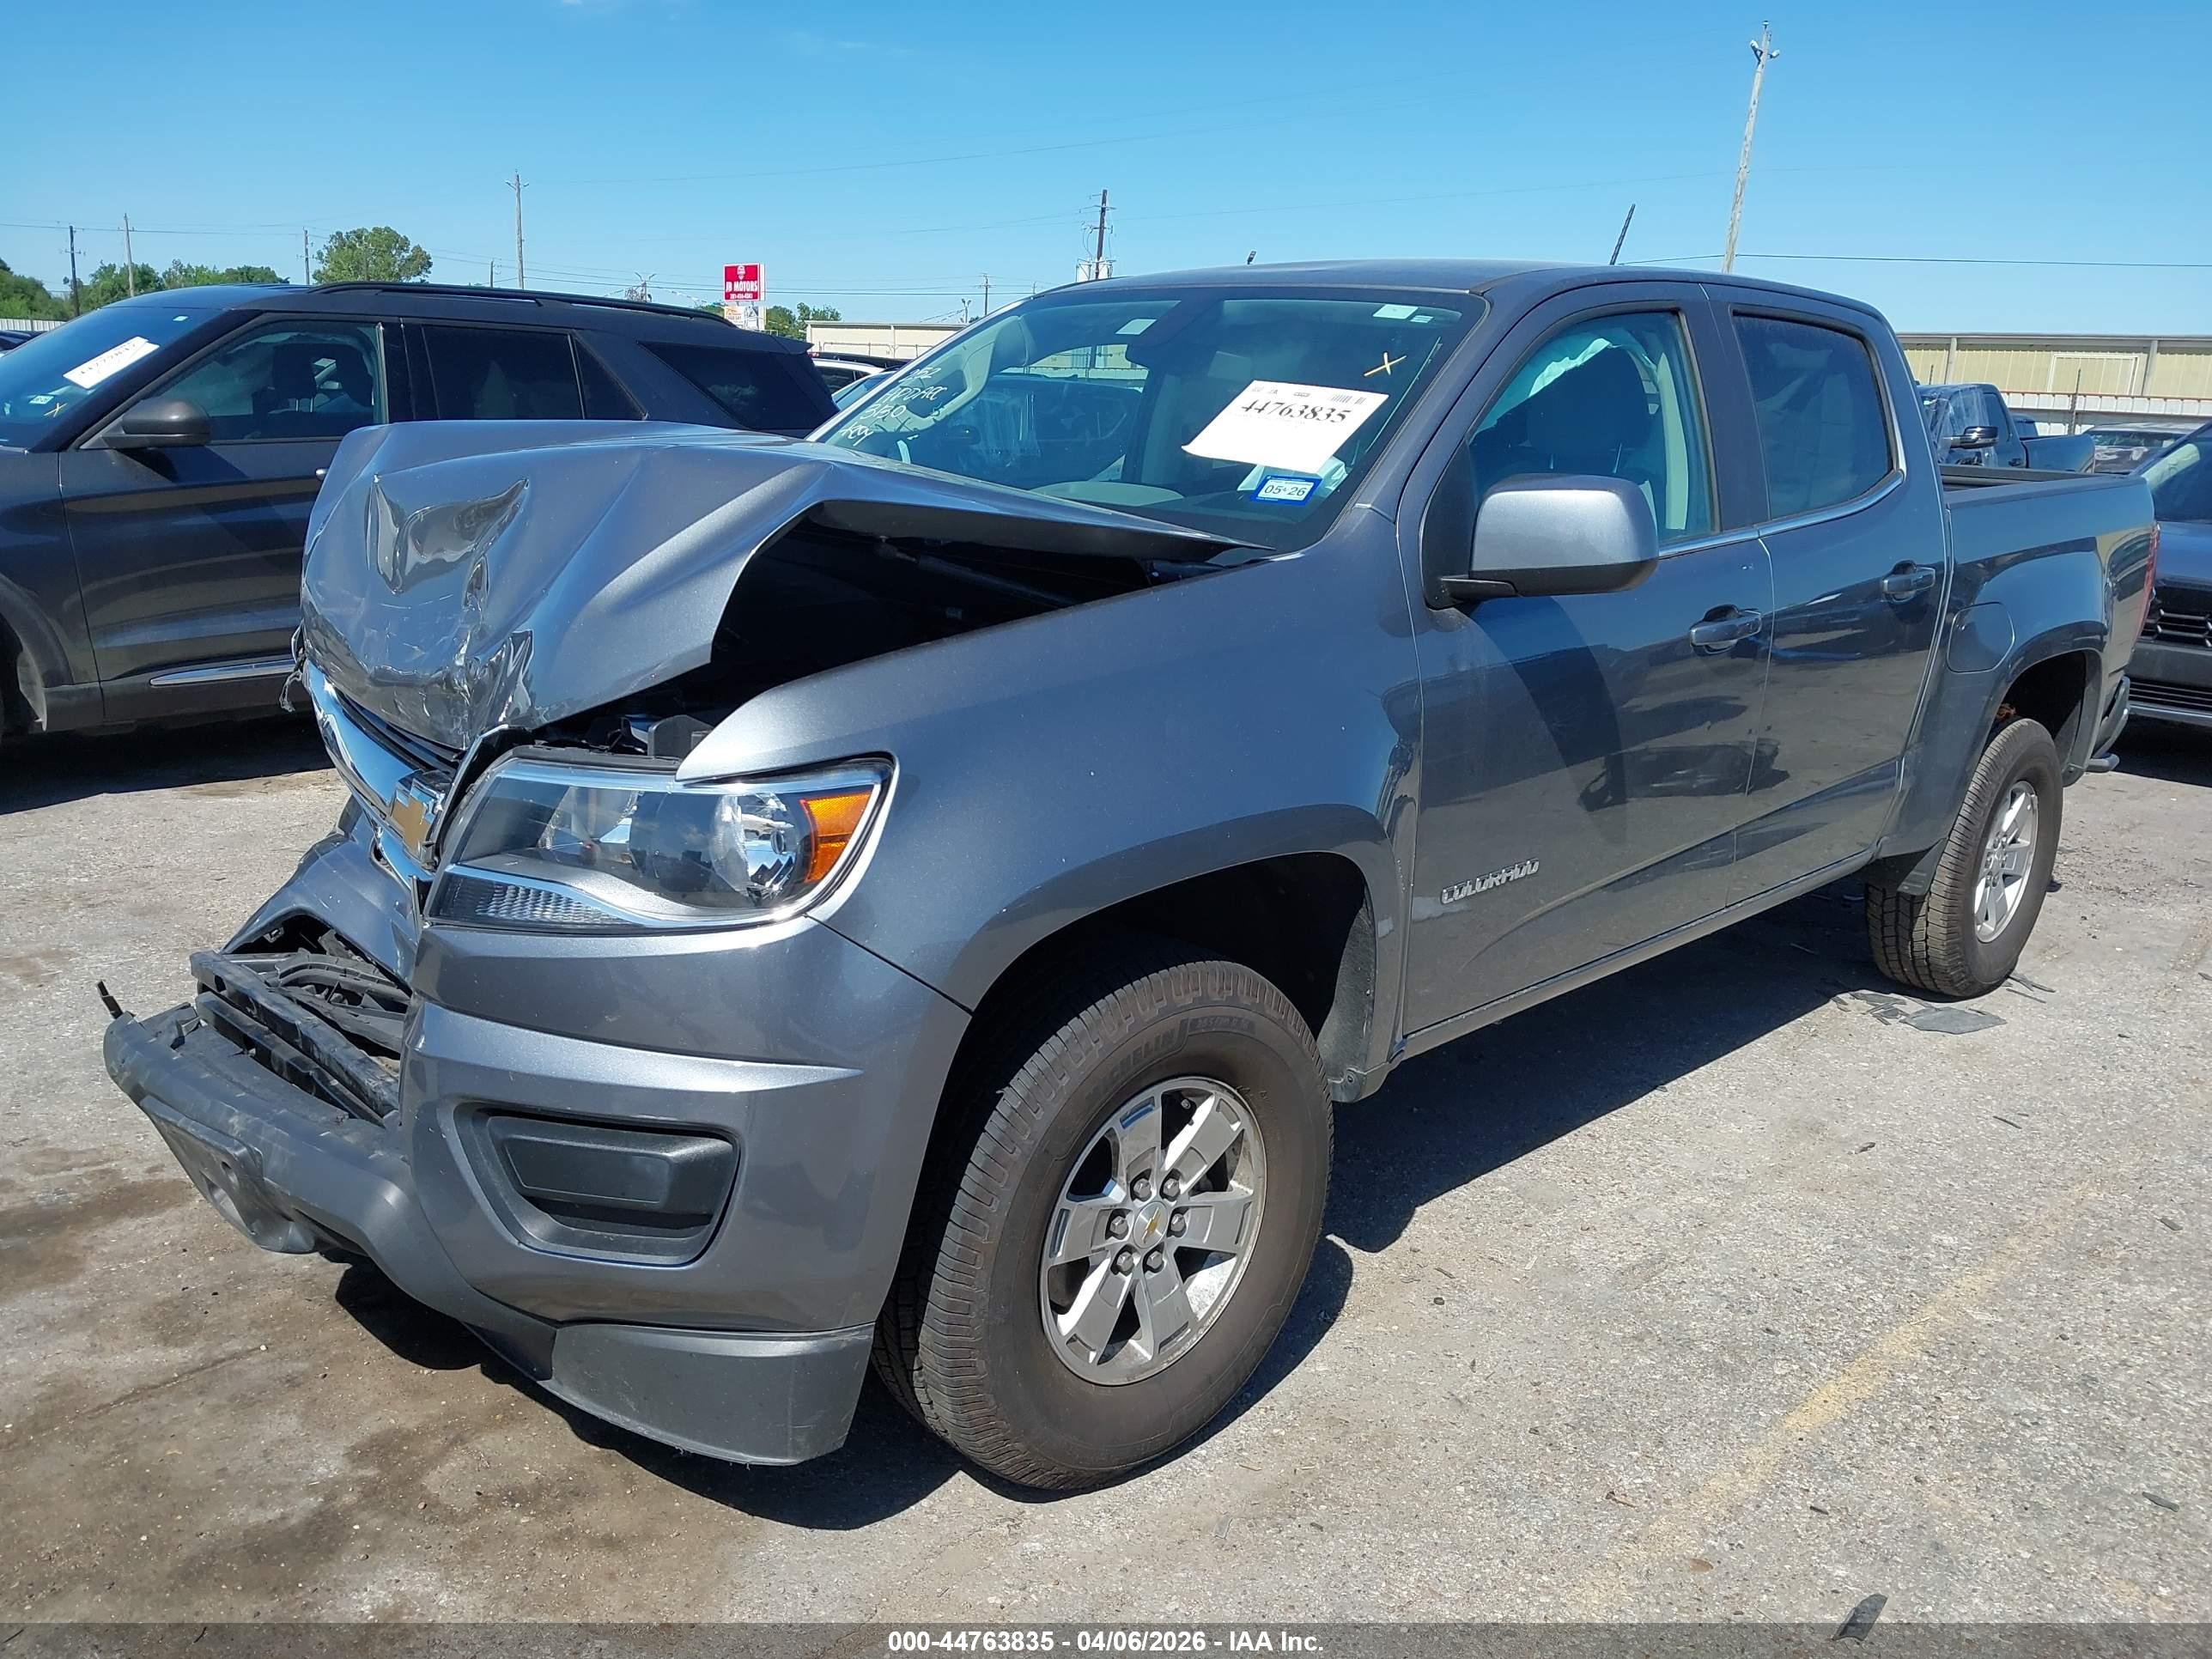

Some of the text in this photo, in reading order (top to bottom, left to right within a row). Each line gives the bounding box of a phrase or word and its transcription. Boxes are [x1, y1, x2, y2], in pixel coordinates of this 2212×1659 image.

[734, 281, 757, 292] MOTORS
[1242, 398, 1352, 424] 44763835
[1440, 857, 1540, 904] COLORADO
